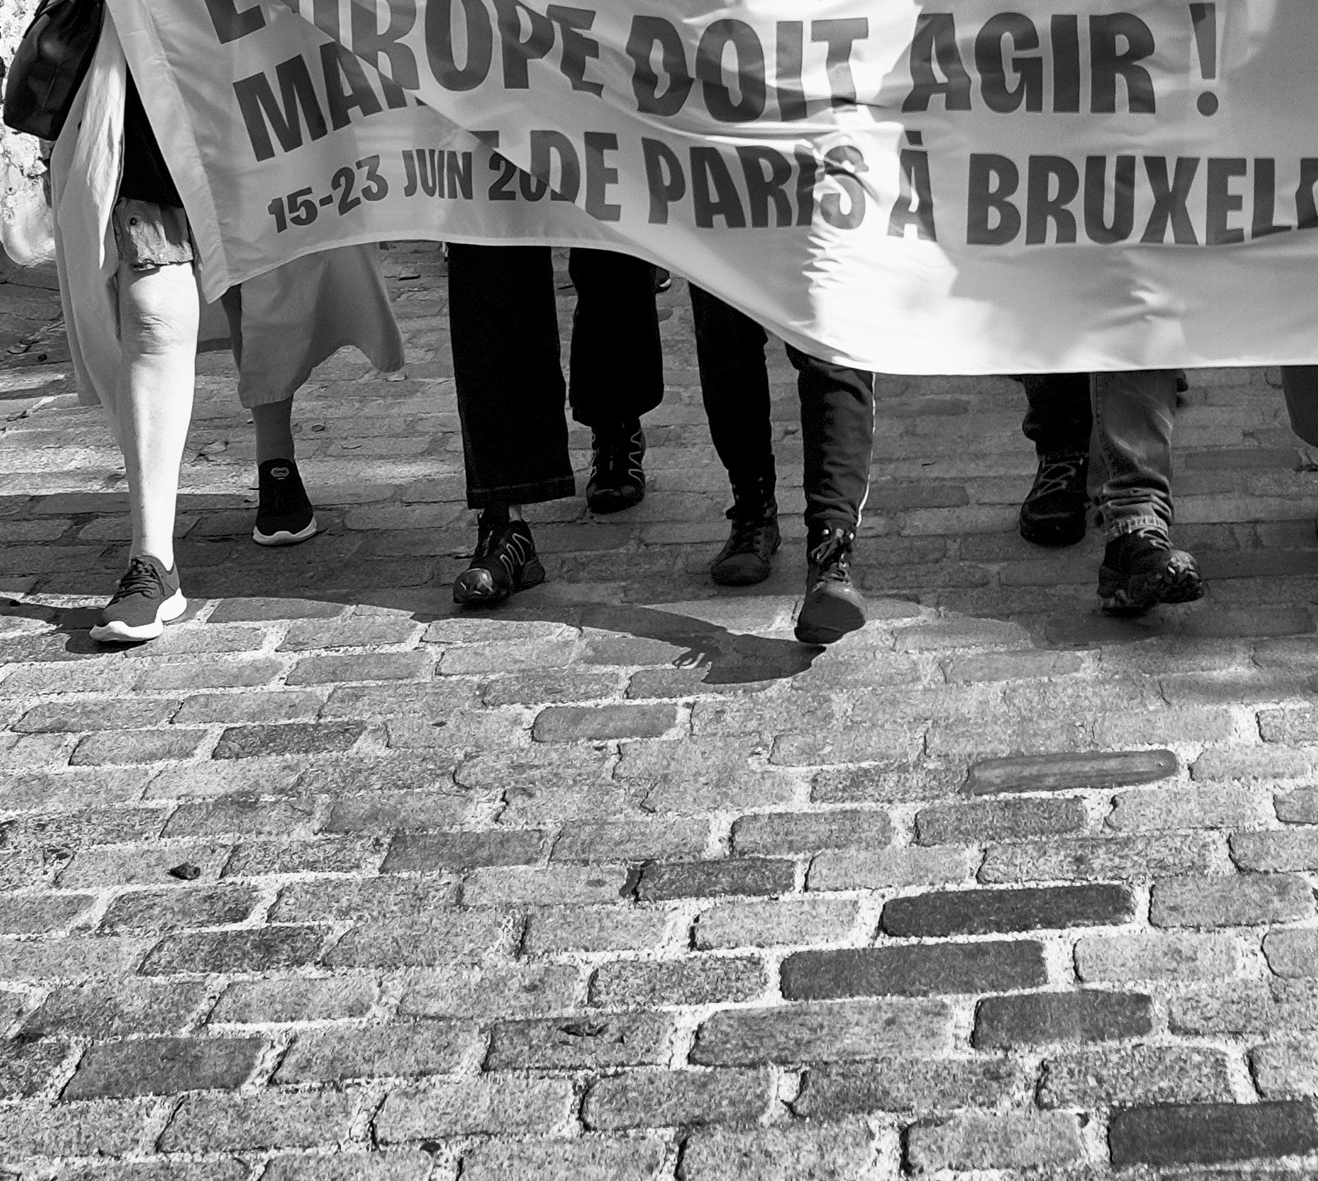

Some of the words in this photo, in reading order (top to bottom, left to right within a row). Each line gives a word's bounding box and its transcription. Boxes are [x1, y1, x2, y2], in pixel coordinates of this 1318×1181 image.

[625, 13, 869, 122] DOIT
[901, 11, 1156, 115] AGIR
[1188, 2, 1219, 117] !
[267, 154, 389, 233] 15-23
[402, 148, 474, 201] JUIN
[641, 135, 868, 231] PARIS
[887, 130, 937, 242] À
